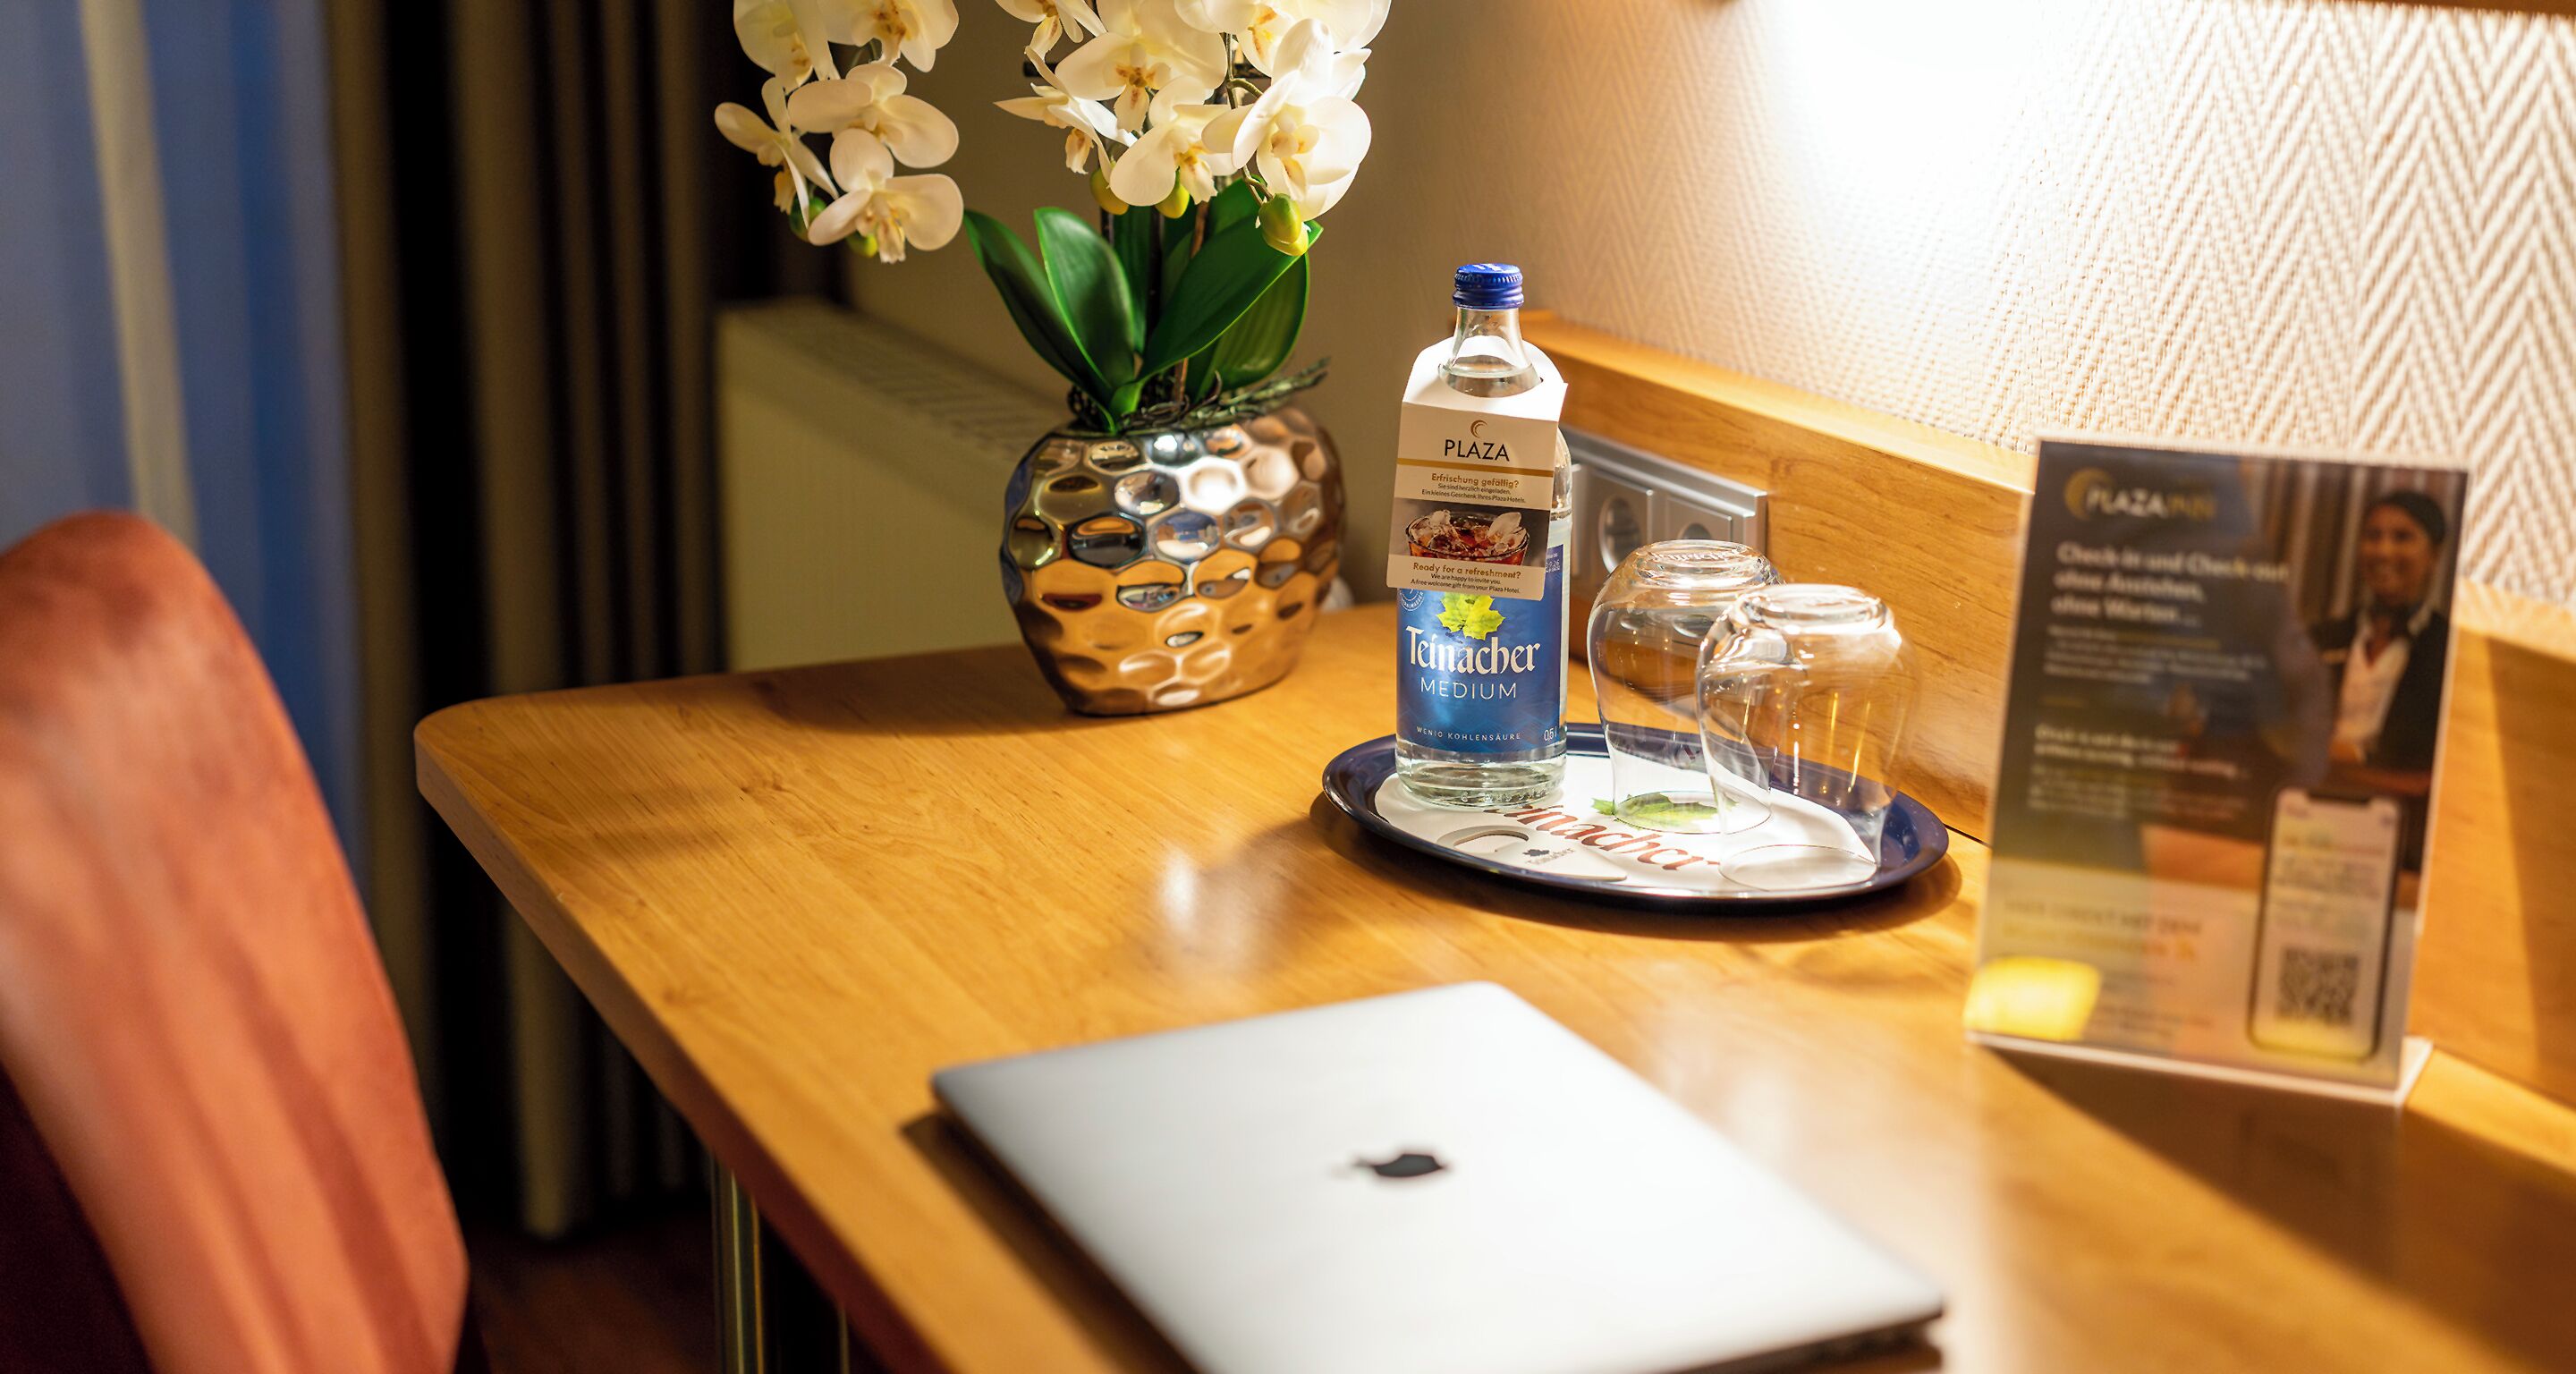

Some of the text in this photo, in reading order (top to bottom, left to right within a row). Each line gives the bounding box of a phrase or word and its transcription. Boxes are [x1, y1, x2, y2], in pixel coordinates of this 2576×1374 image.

[1444, 439, 1510, 462] PLAZA
[1431, 473, 1520, 488] Erfrischung gefällig?
[1451, 491, 1477, 499] Geschenk
[2085, 486, 2168, 519] PLAZA
[1413, 562, 1440, 573] Ready
[1443, 564, 1455, 573] for
[1465, 566, 1521, 579] refreshment?
[2143, 551, 2184, 572] und
[1406, 626, 1540, 674] Teinacher
[1420, 677, 1517, 700] MEDIUM
[1416, 726, 1521, 742] WENIG KOHLENSÄURE
